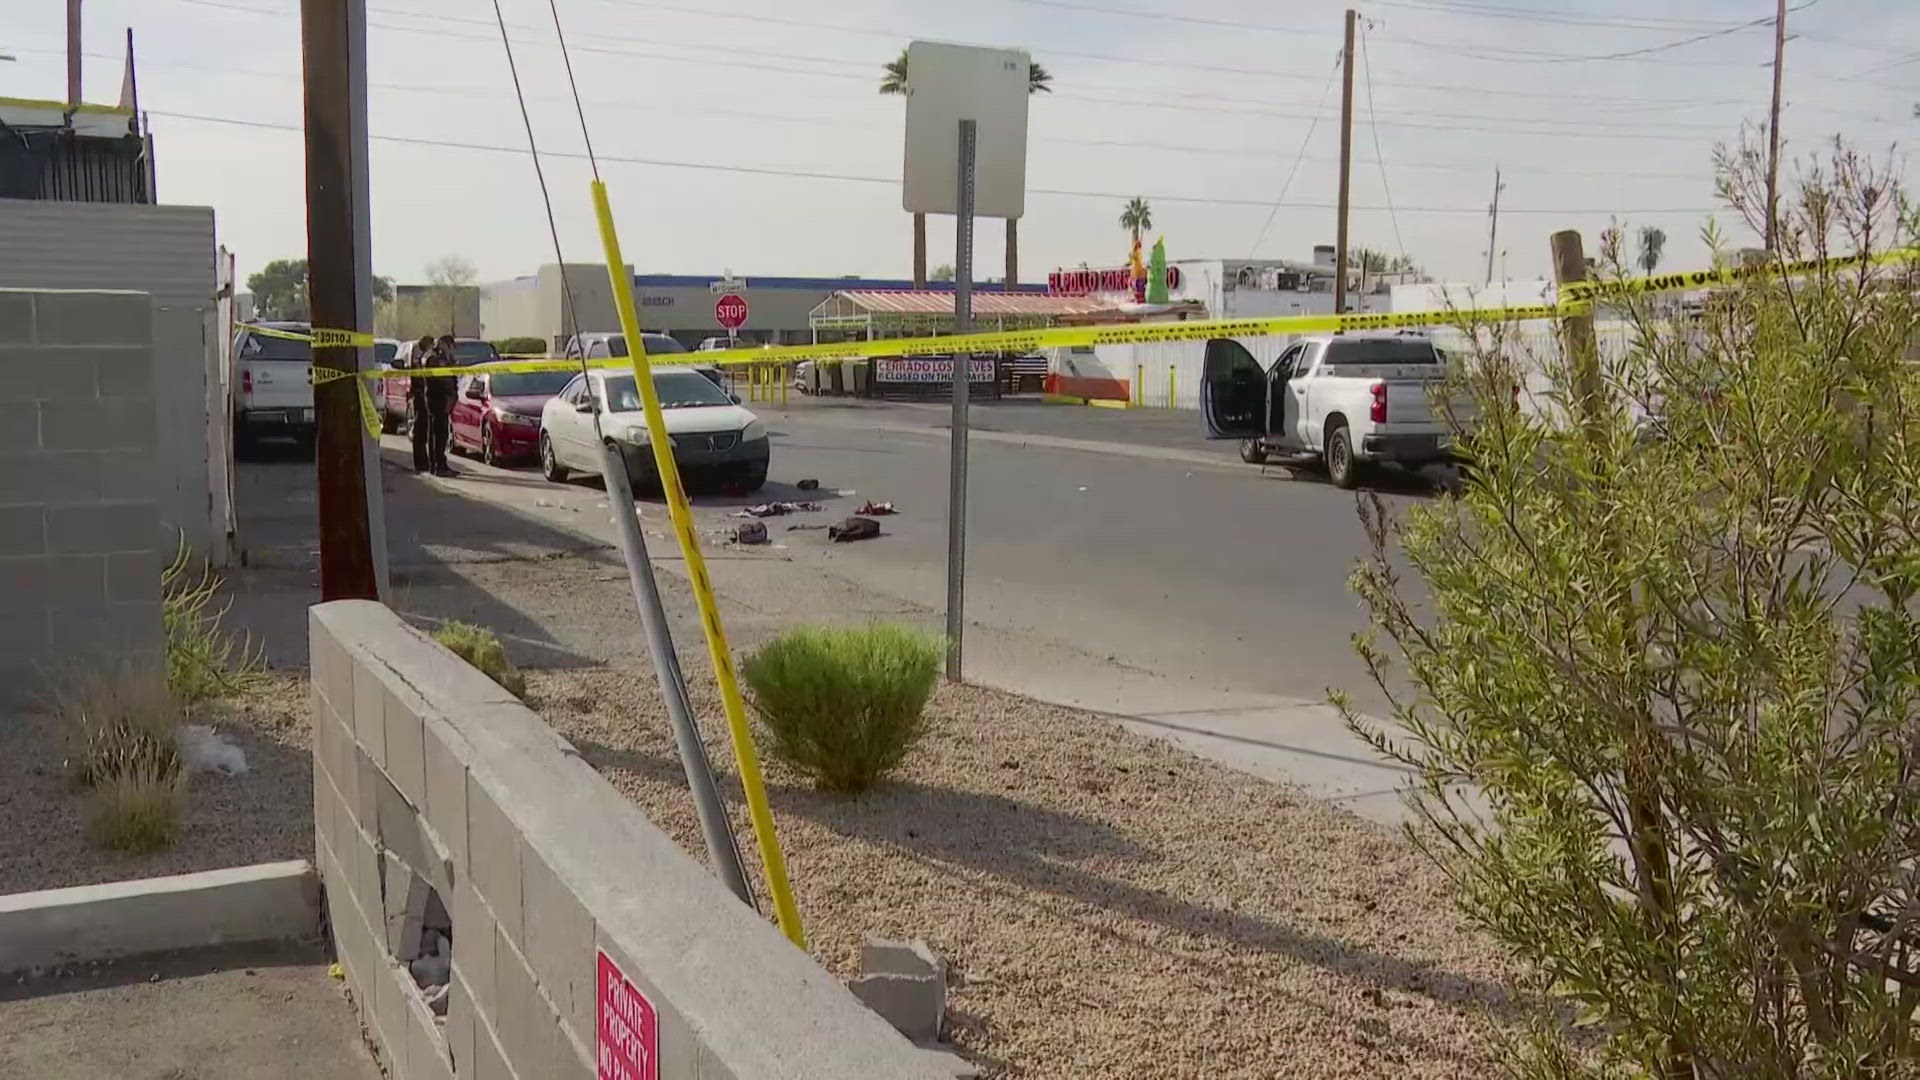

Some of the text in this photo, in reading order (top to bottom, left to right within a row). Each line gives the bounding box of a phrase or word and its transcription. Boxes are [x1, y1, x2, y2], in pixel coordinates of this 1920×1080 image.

[1061, 271, 1099, 292] POLLO
[717, 304, 746, 319] STOP
[878, 361, 931, 372] CERRADO
[932, 361, 953, 372] LOS
[885, 372, 920, 381] CLOSED
[921, 372, 935, 381] ON
[608, 970, 644, 1040] PRIVATE
[603, 999, 648, 1080] PROPERTY
[600, 1037, 612, 1078] NO
